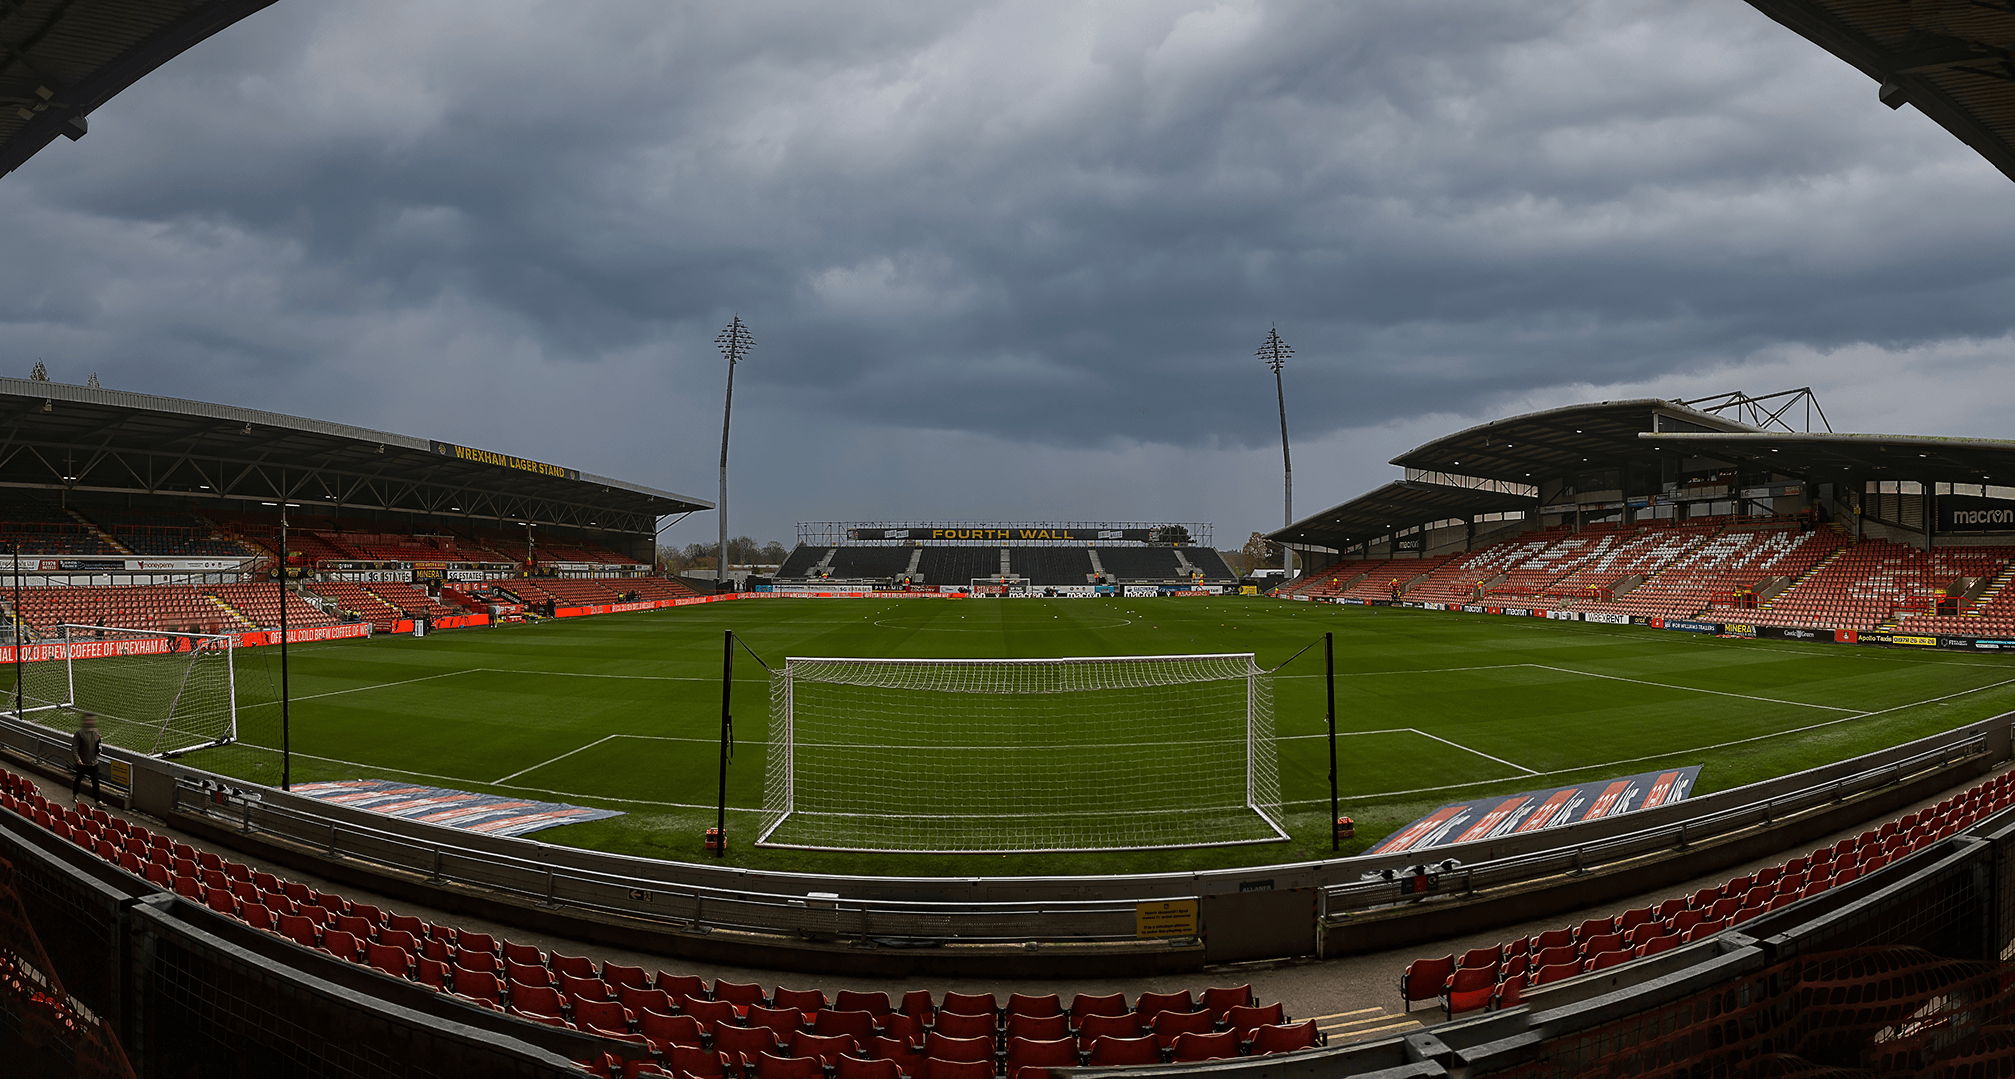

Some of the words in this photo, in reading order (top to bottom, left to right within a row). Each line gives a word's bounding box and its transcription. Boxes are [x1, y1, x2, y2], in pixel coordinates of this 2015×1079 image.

[454, 445, 507, 466] WREXHAM
[509, 456, 537, 473] LAGER
[538, 462, 565, 478] STAND
[1954, 510, 2014, 524] macron
[932, 530, 1010, 539] FOURTH
[1019, 530, 1074, 539] WALL
[416, 570, 440, 578] MINERA
[449, 572, 457, 580] SG
[459, 572, 482, 580] ESTATES
[1506, 608, 1527, 617] macron
[1724, 624, 1752, 633] MINERA
[298, 628, 312, 642] COLD
[314, 627, 331, 641] BREW
[332, 626, 351, 639] COFFEE
[352, 625, 359, 637] OF
[1858, 634, 1876, 642] Apollo
[42, 645, 67, 660] BREW
[70, 643, 101, 659] COFFEE
[104, 642, 114, 656] OF
[117, 640, 158, 655] WREXHAM
